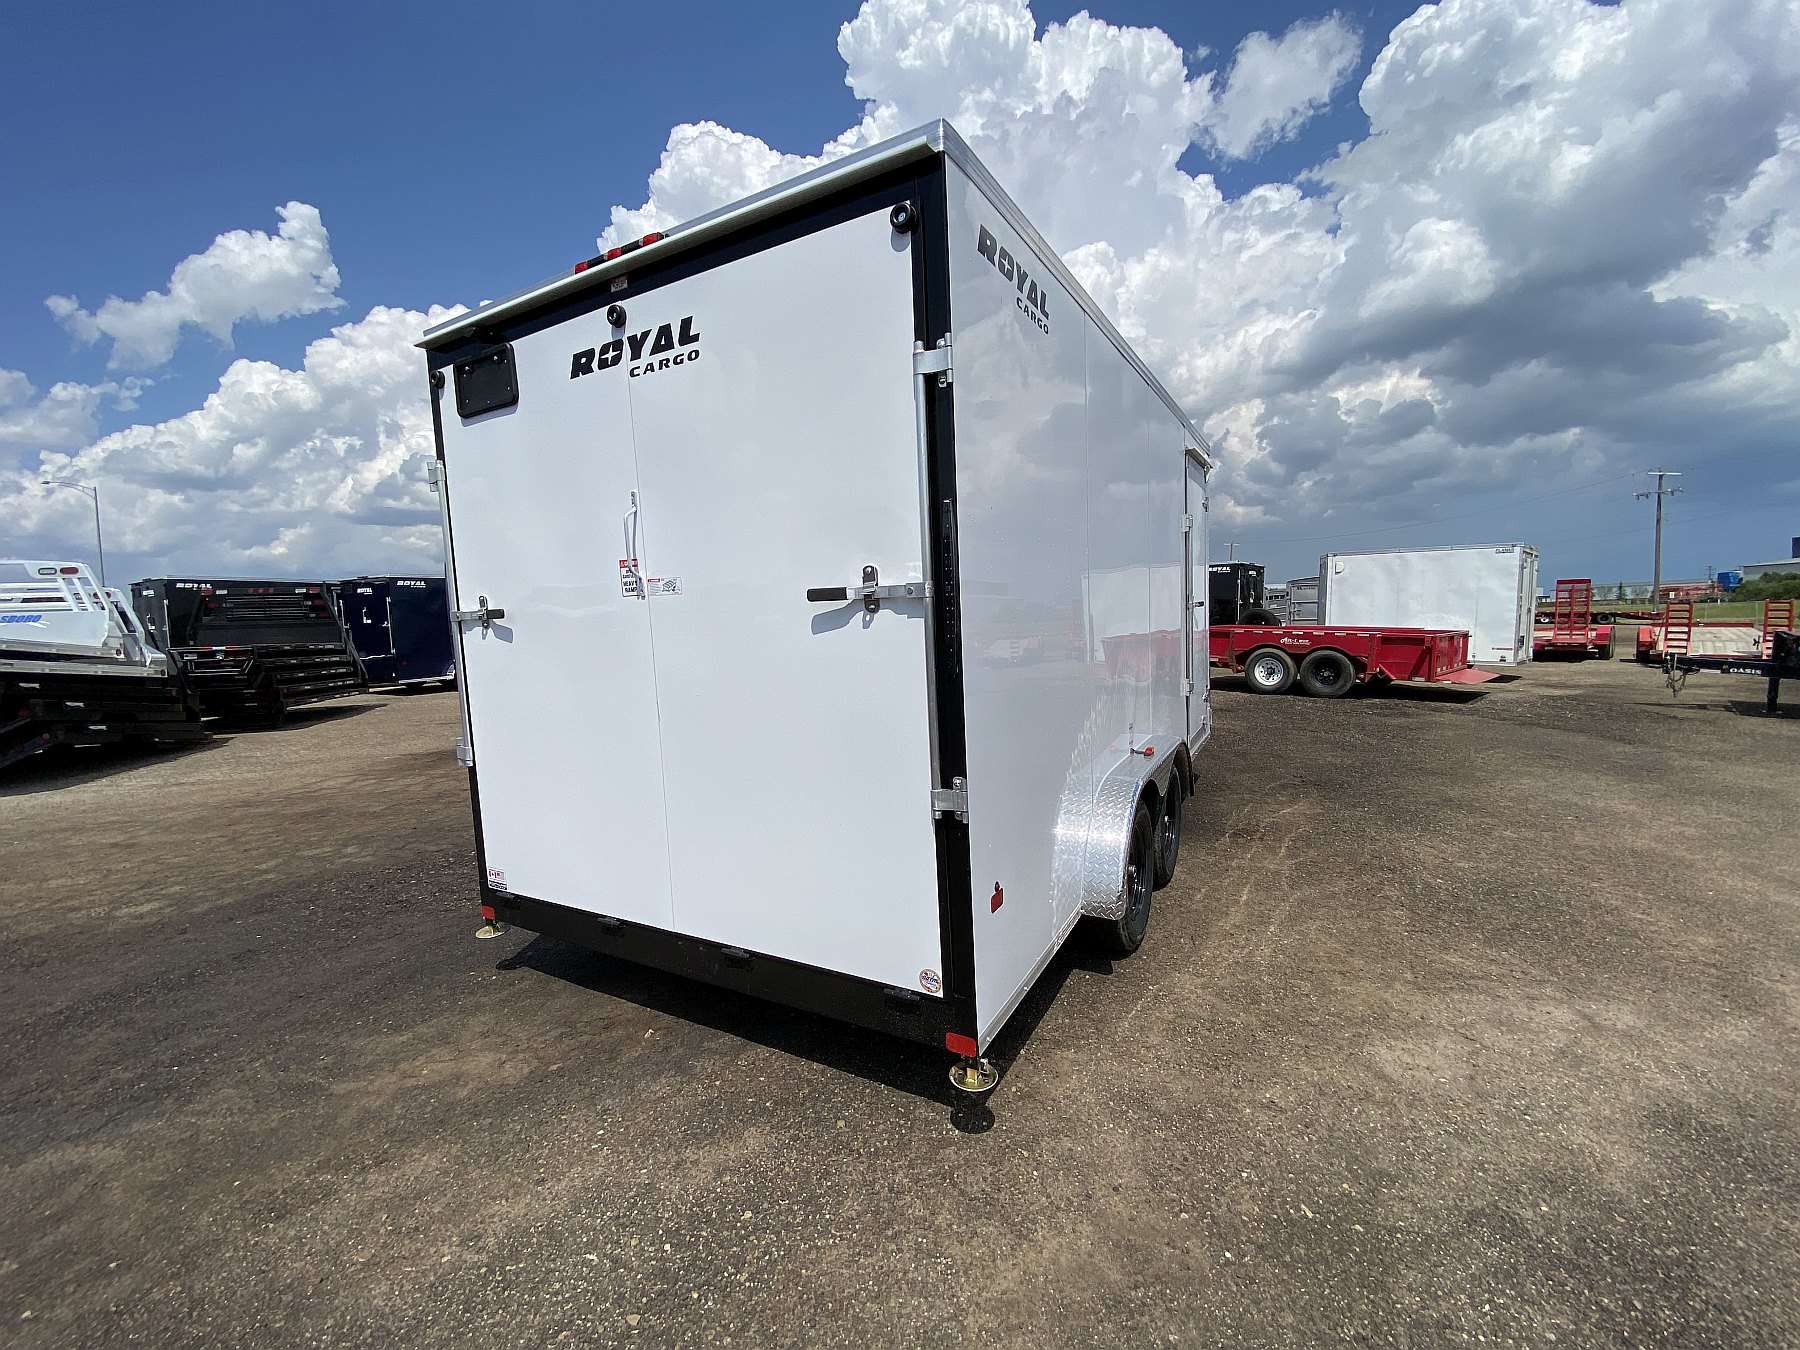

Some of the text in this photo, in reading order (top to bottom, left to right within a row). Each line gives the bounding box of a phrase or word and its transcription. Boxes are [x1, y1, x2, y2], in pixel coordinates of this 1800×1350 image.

[977, 224, 1050, 321] ROYAL
[1016, 296, 1049, 335] CARGO
[570, 315, 701, 380] ROYAL
[629, 349, 700, 378] CARGO
[176, 582, 213, 590] ROYAL
[1729, 667, 1762, 675] OASIS
